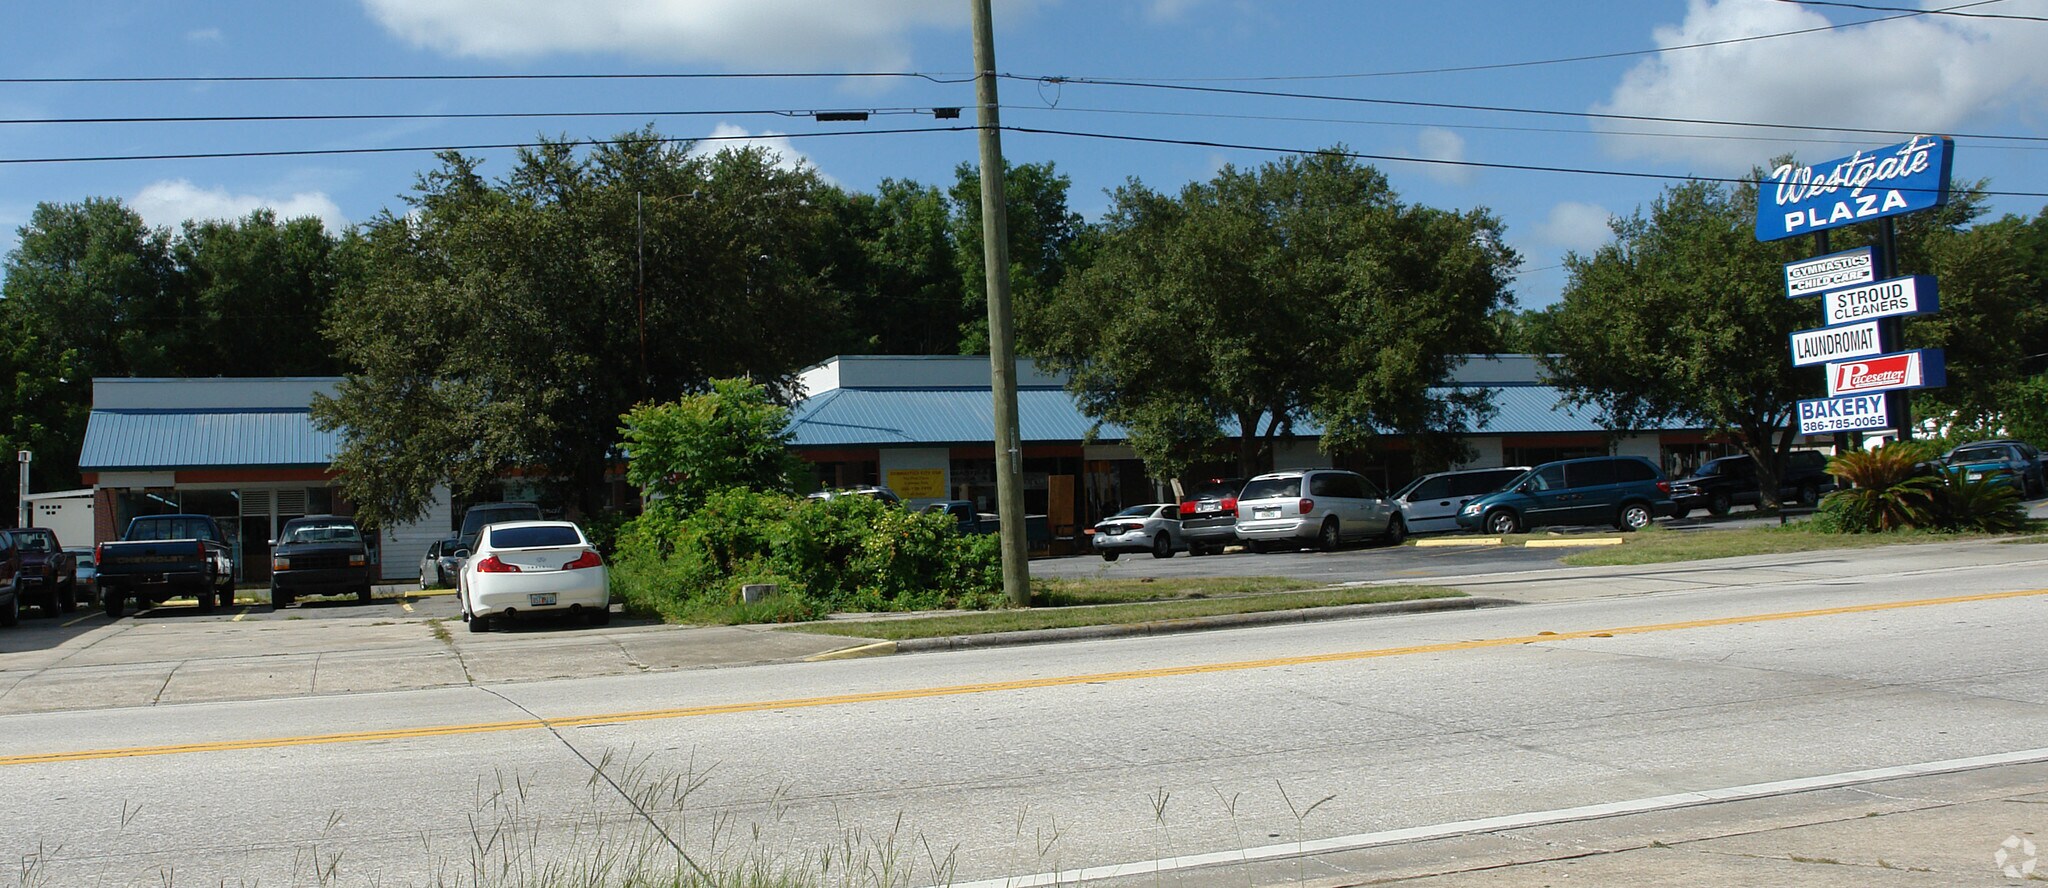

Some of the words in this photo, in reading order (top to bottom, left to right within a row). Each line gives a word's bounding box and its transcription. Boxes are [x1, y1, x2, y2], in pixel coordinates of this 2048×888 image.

[1771, 136, 1936, 205] Westgate
[1784, 190, 1907, 233] PLAZA
[1791, 255, 1869, 278] GYMNASTICS
[1796, 276, 1831, 291] CHILD
[1833, 270, 1865, 284] CARE
[1837, 284, 1903, 308] STROUD
[1834, 297, 1909, 320] CLEANERS
[1796, 328, 1874, 359] LAUNDROMAT
[1801, 395, 1882, 419] BAKERY
[1803, 415, 1885, 431] 386-785-0065
